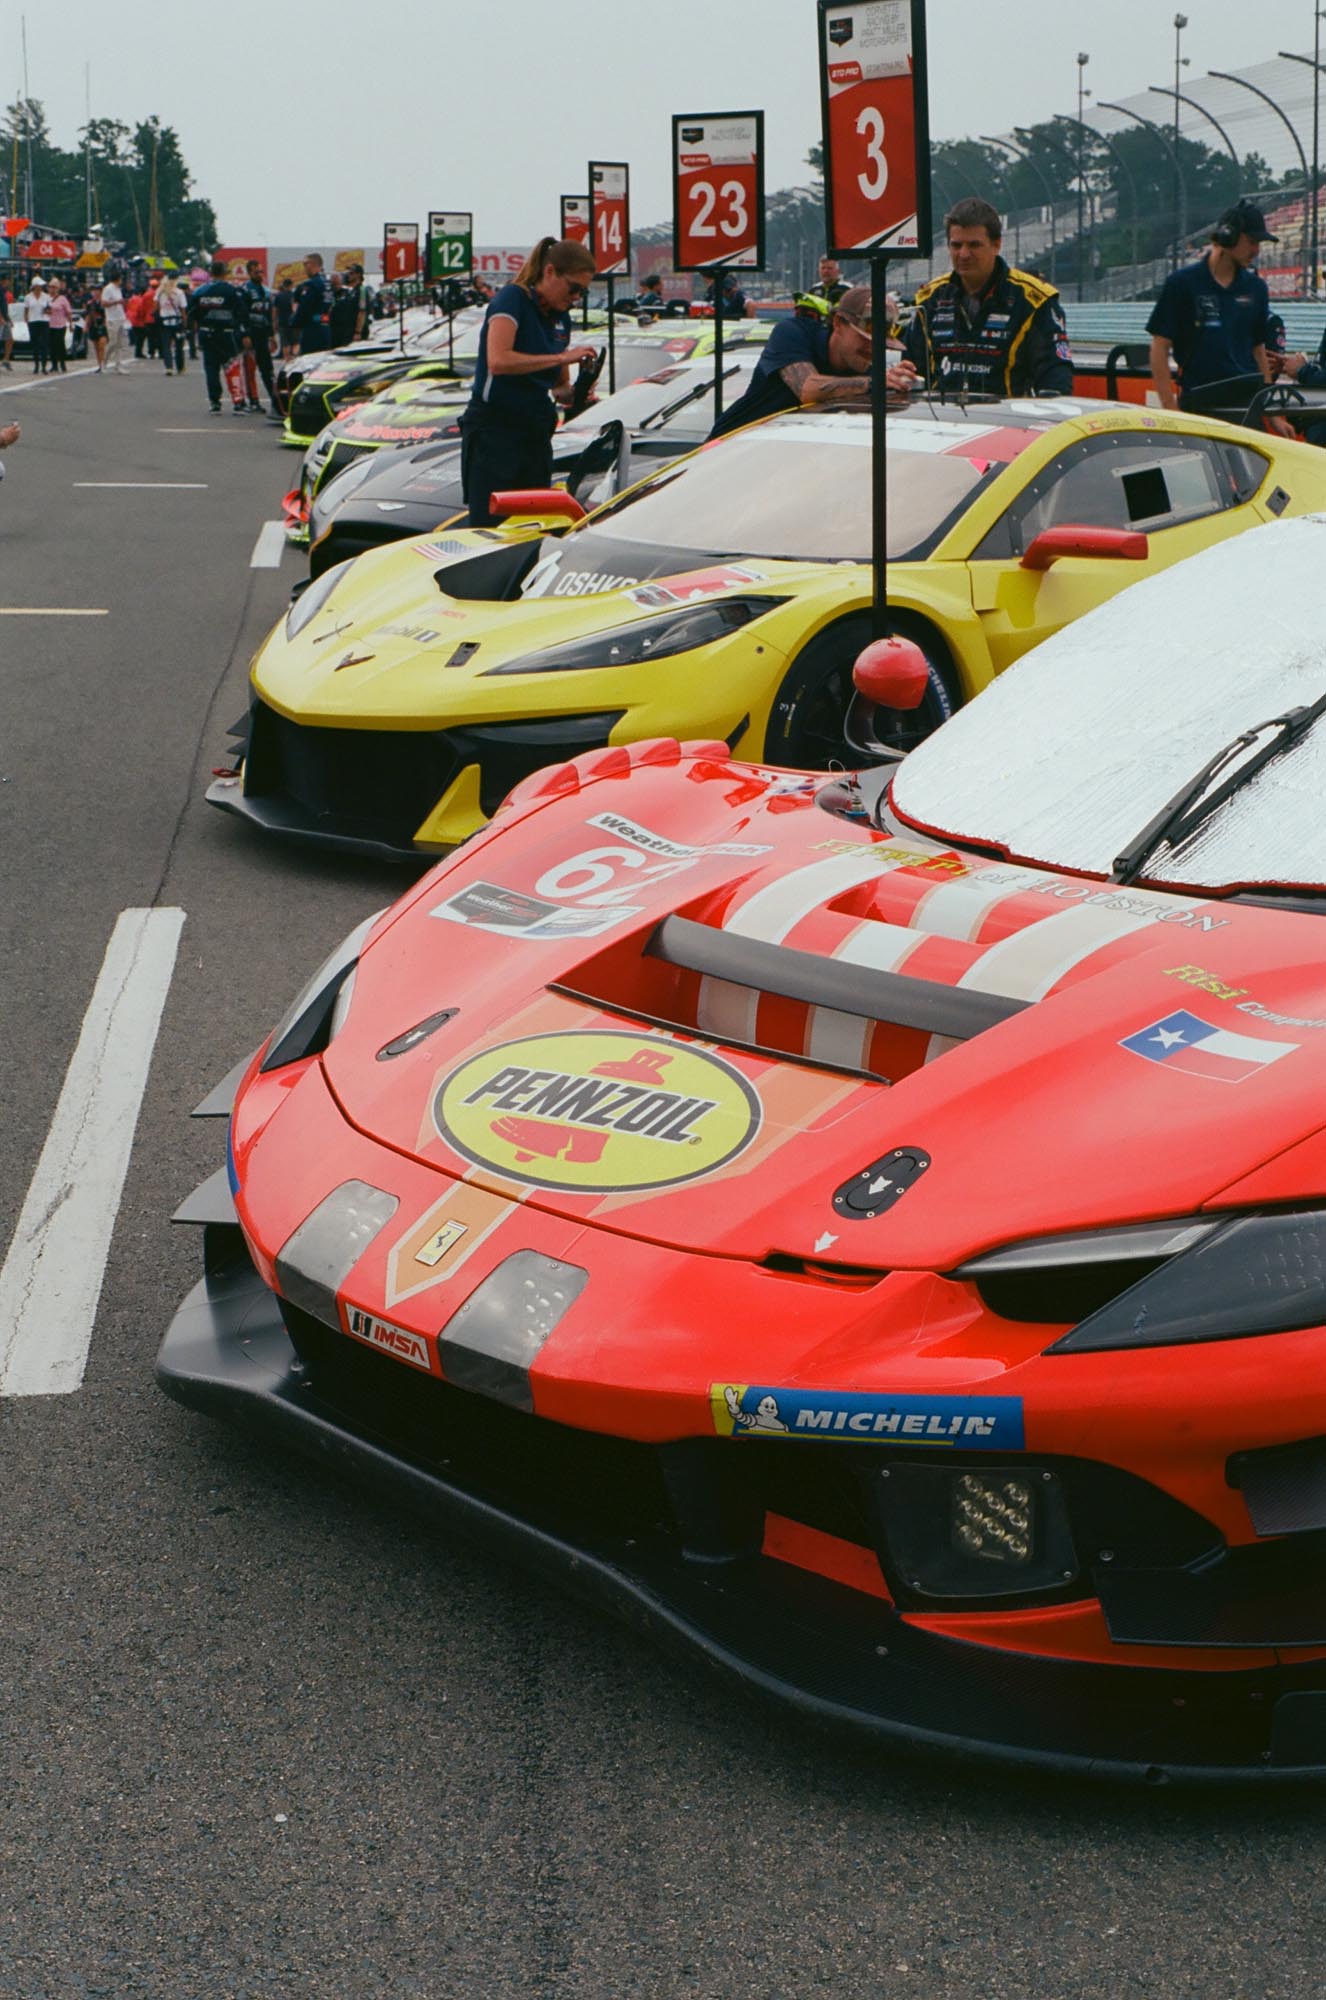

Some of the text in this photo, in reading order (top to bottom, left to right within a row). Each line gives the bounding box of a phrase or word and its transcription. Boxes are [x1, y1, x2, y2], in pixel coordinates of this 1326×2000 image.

[856, 106, 888, 200] 3
[597, 210, 622, 253] 14
[689, 181, 748, 238] 23
[396, 247, 406, 271] 1
[438, 241, 464, 267] 12
[925, 658, 952, 721] CHELIN
[535, 846, 699, 905] 62
[1017, 879, 1230, 932] HOUSTON
[1162, 965, 1248, 1000] Risi
[464, 1067, 717, 1142] PENNZOIL
[373, 1325, 427, 1362] IMSA
[795, 1408, 996, 1436] MICHELIN
